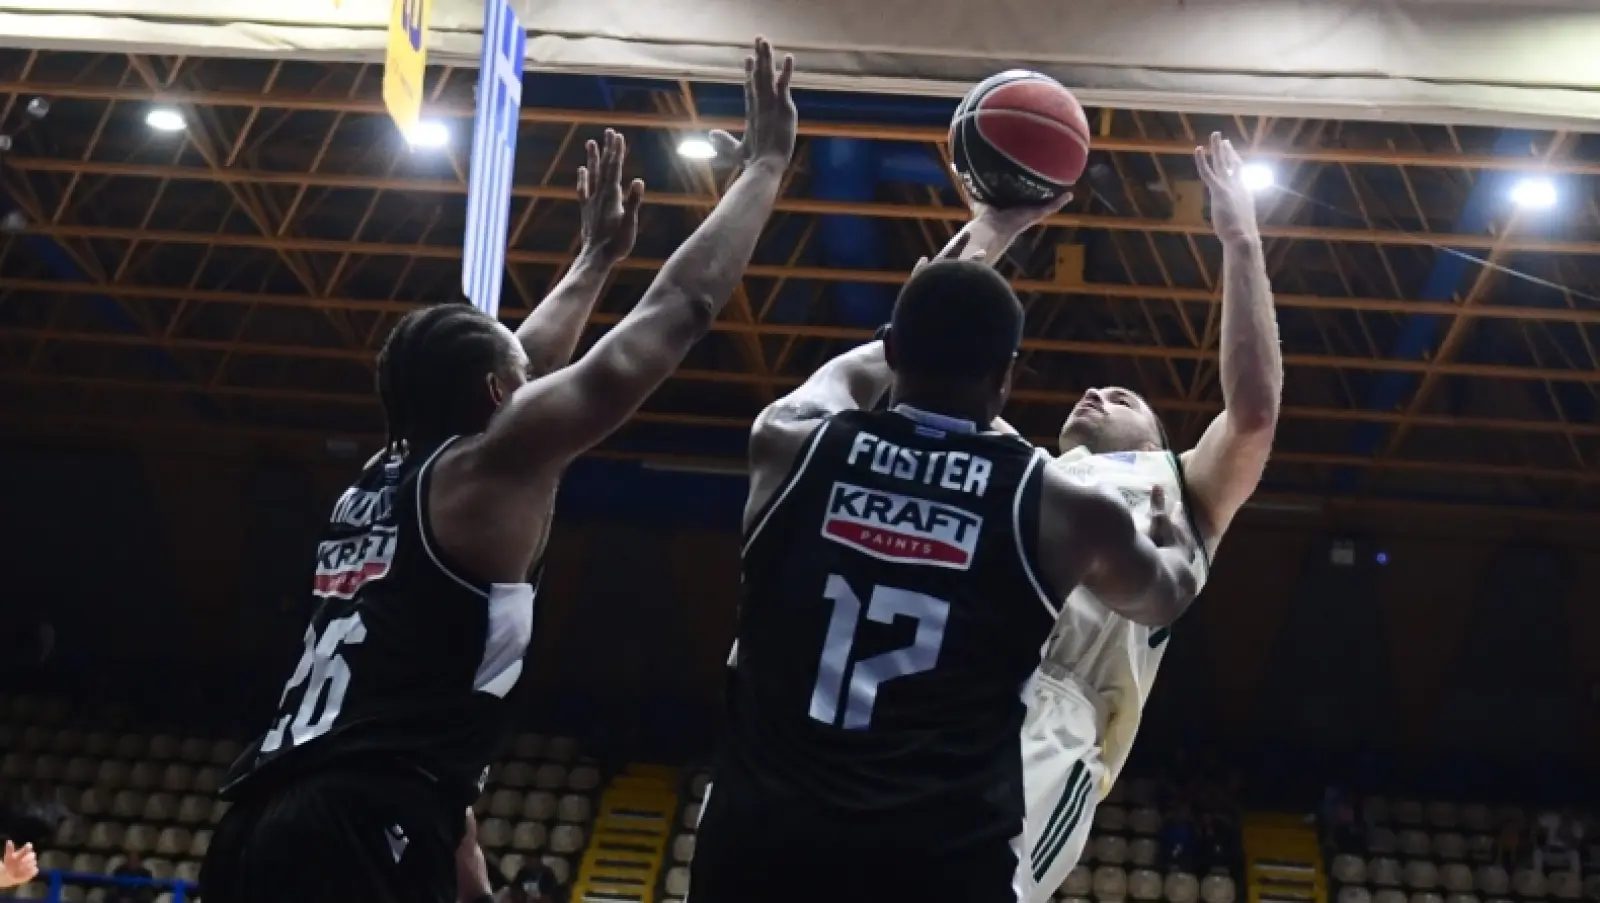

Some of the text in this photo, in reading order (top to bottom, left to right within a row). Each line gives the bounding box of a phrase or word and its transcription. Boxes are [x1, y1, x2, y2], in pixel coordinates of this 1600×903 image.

[847, 431, 993, 497] FOSTER
[831, 486, 976, 543] KRAFT
[860, 530, 933, 554] PAINTS
